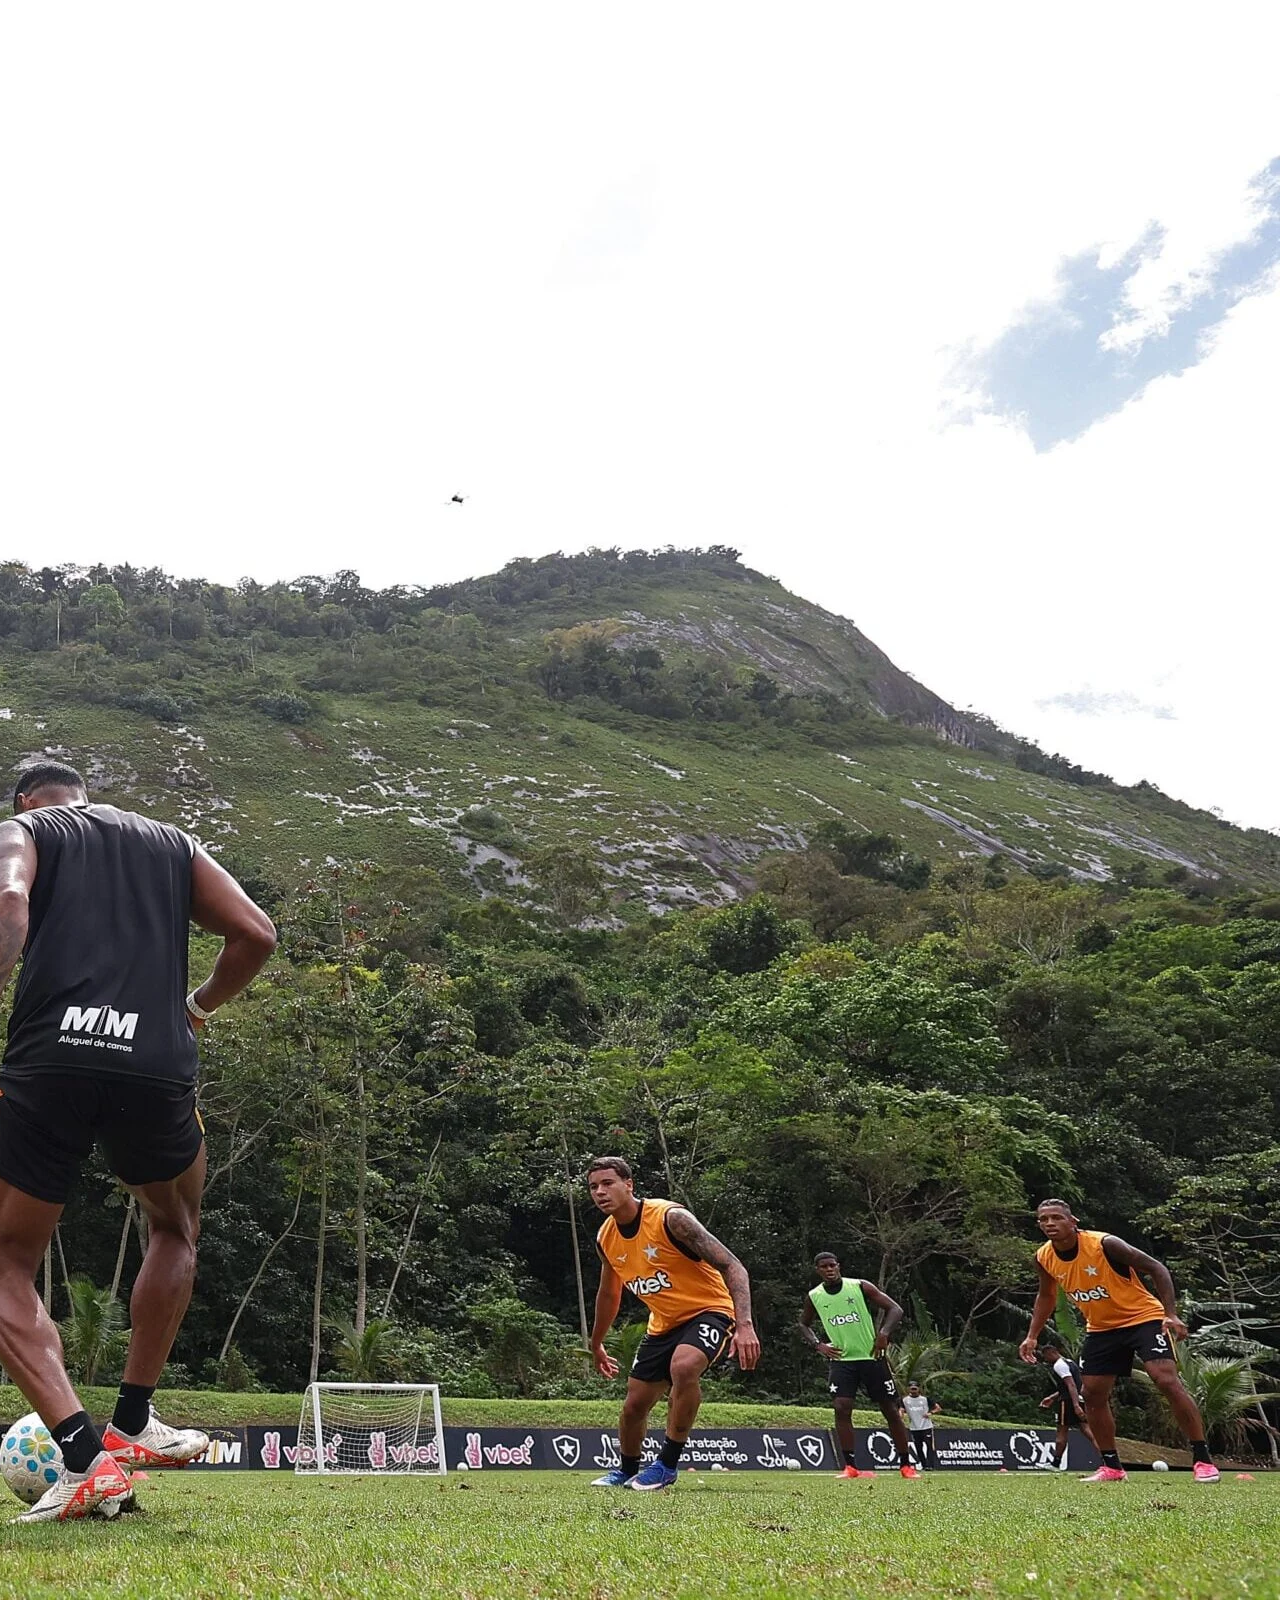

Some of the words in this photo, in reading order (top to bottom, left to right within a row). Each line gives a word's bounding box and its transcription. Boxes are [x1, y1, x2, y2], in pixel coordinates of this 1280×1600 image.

[58, 1035, 93, 1046] Aluguel
[93, 1039, 105, 1048] de
[106, 1042, 133, 1052] carros
[628, 1271, 672, 1296] vbet
[1070, 1286, 1110, 1302] vbet
[829, 1311, 860, 1326] vbet
[698, 1323, 720, 1344] 30
[642, 1437, 662, 1450] Oh,
[684, 1436, 738, 1451] dratação
[949, 1440, 987, 1450] MÁXIMA
[388, 1443, 439, 1463] vbet
[484, 1444, 532, 1464] vbet
[691, 1451, 748, 1464] Botafogo
[936, 1450, 1004, 1459] PERFORMANCE
